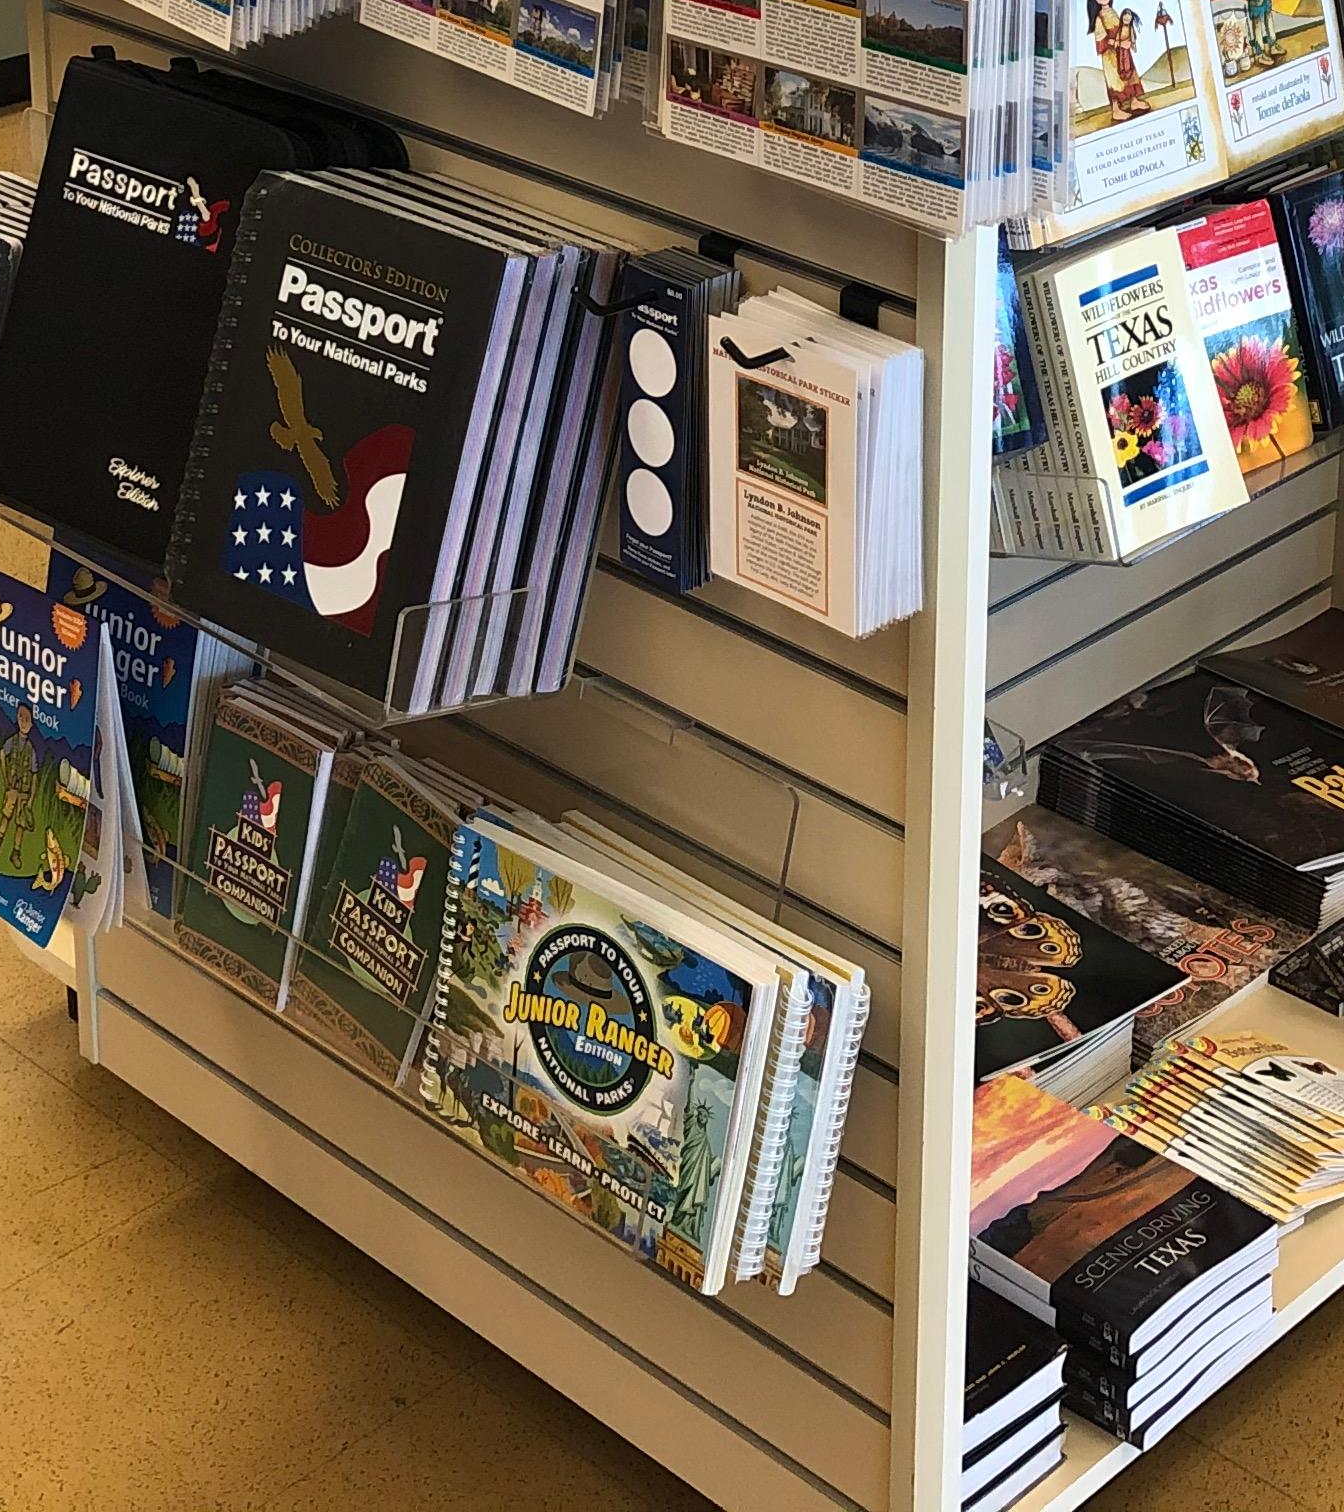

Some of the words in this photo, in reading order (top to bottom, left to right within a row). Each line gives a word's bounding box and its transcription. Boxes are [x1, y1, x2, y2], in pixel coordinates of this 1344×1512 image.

[68, 152, 185, 211] Passport
[287, 232, 382, 283] COLLECTOR'S
[384, 261, 450, 304] EDITION
[276, 263, 443, 357] Passport
[1081, 279, 1165, 324] WILDFLOWERS
[270, 320, 289, 341] To
[290, 324, 320, 358] Your
[321, 334, 382, 379] National
[383, 357, 429, 393] Parks
[1086, 305, 1174, 367] TEXAS
[1095, 363, 1121, 385] HILL
[1122, 339, 1177, 372] COUNTRY
[799, 378, 819, 395] PARK
[819, 387, 850, 407] STICKER
[743, 489, 776, 511] Lyndon
[777, 503, 786, 516] B.
[787, 506, 821, 531] Johnson
[31, 702, 61, 732] Book
[212, 834, 288, 888] PASSPORT
[215, 876, 278, 922] COMPANION
[538, 934, 597, 967] PASSPORT
[599, 939, 618, 961] TO
[617, 956, 645, 1006] YOUR
[503, 982, 579, 1032] JUNIOR
[586, 1006, 674, 1078] RANGER
[574, 1034, 624, 1068] EDITION
[536, 1036, 591, 1103] NATIONAL
[481, 1093, 541, 1142] EXPLORE
[548, 1138, 593, 1178] LEARN
[599, 1173, 667, 1223] PROTECT
[1073, 1234, 1145, 1289] SCENIC
[1141, 1189, 1213, 1242] DRIVING
[1133, 1228, 1208, 1277] TEXAS
